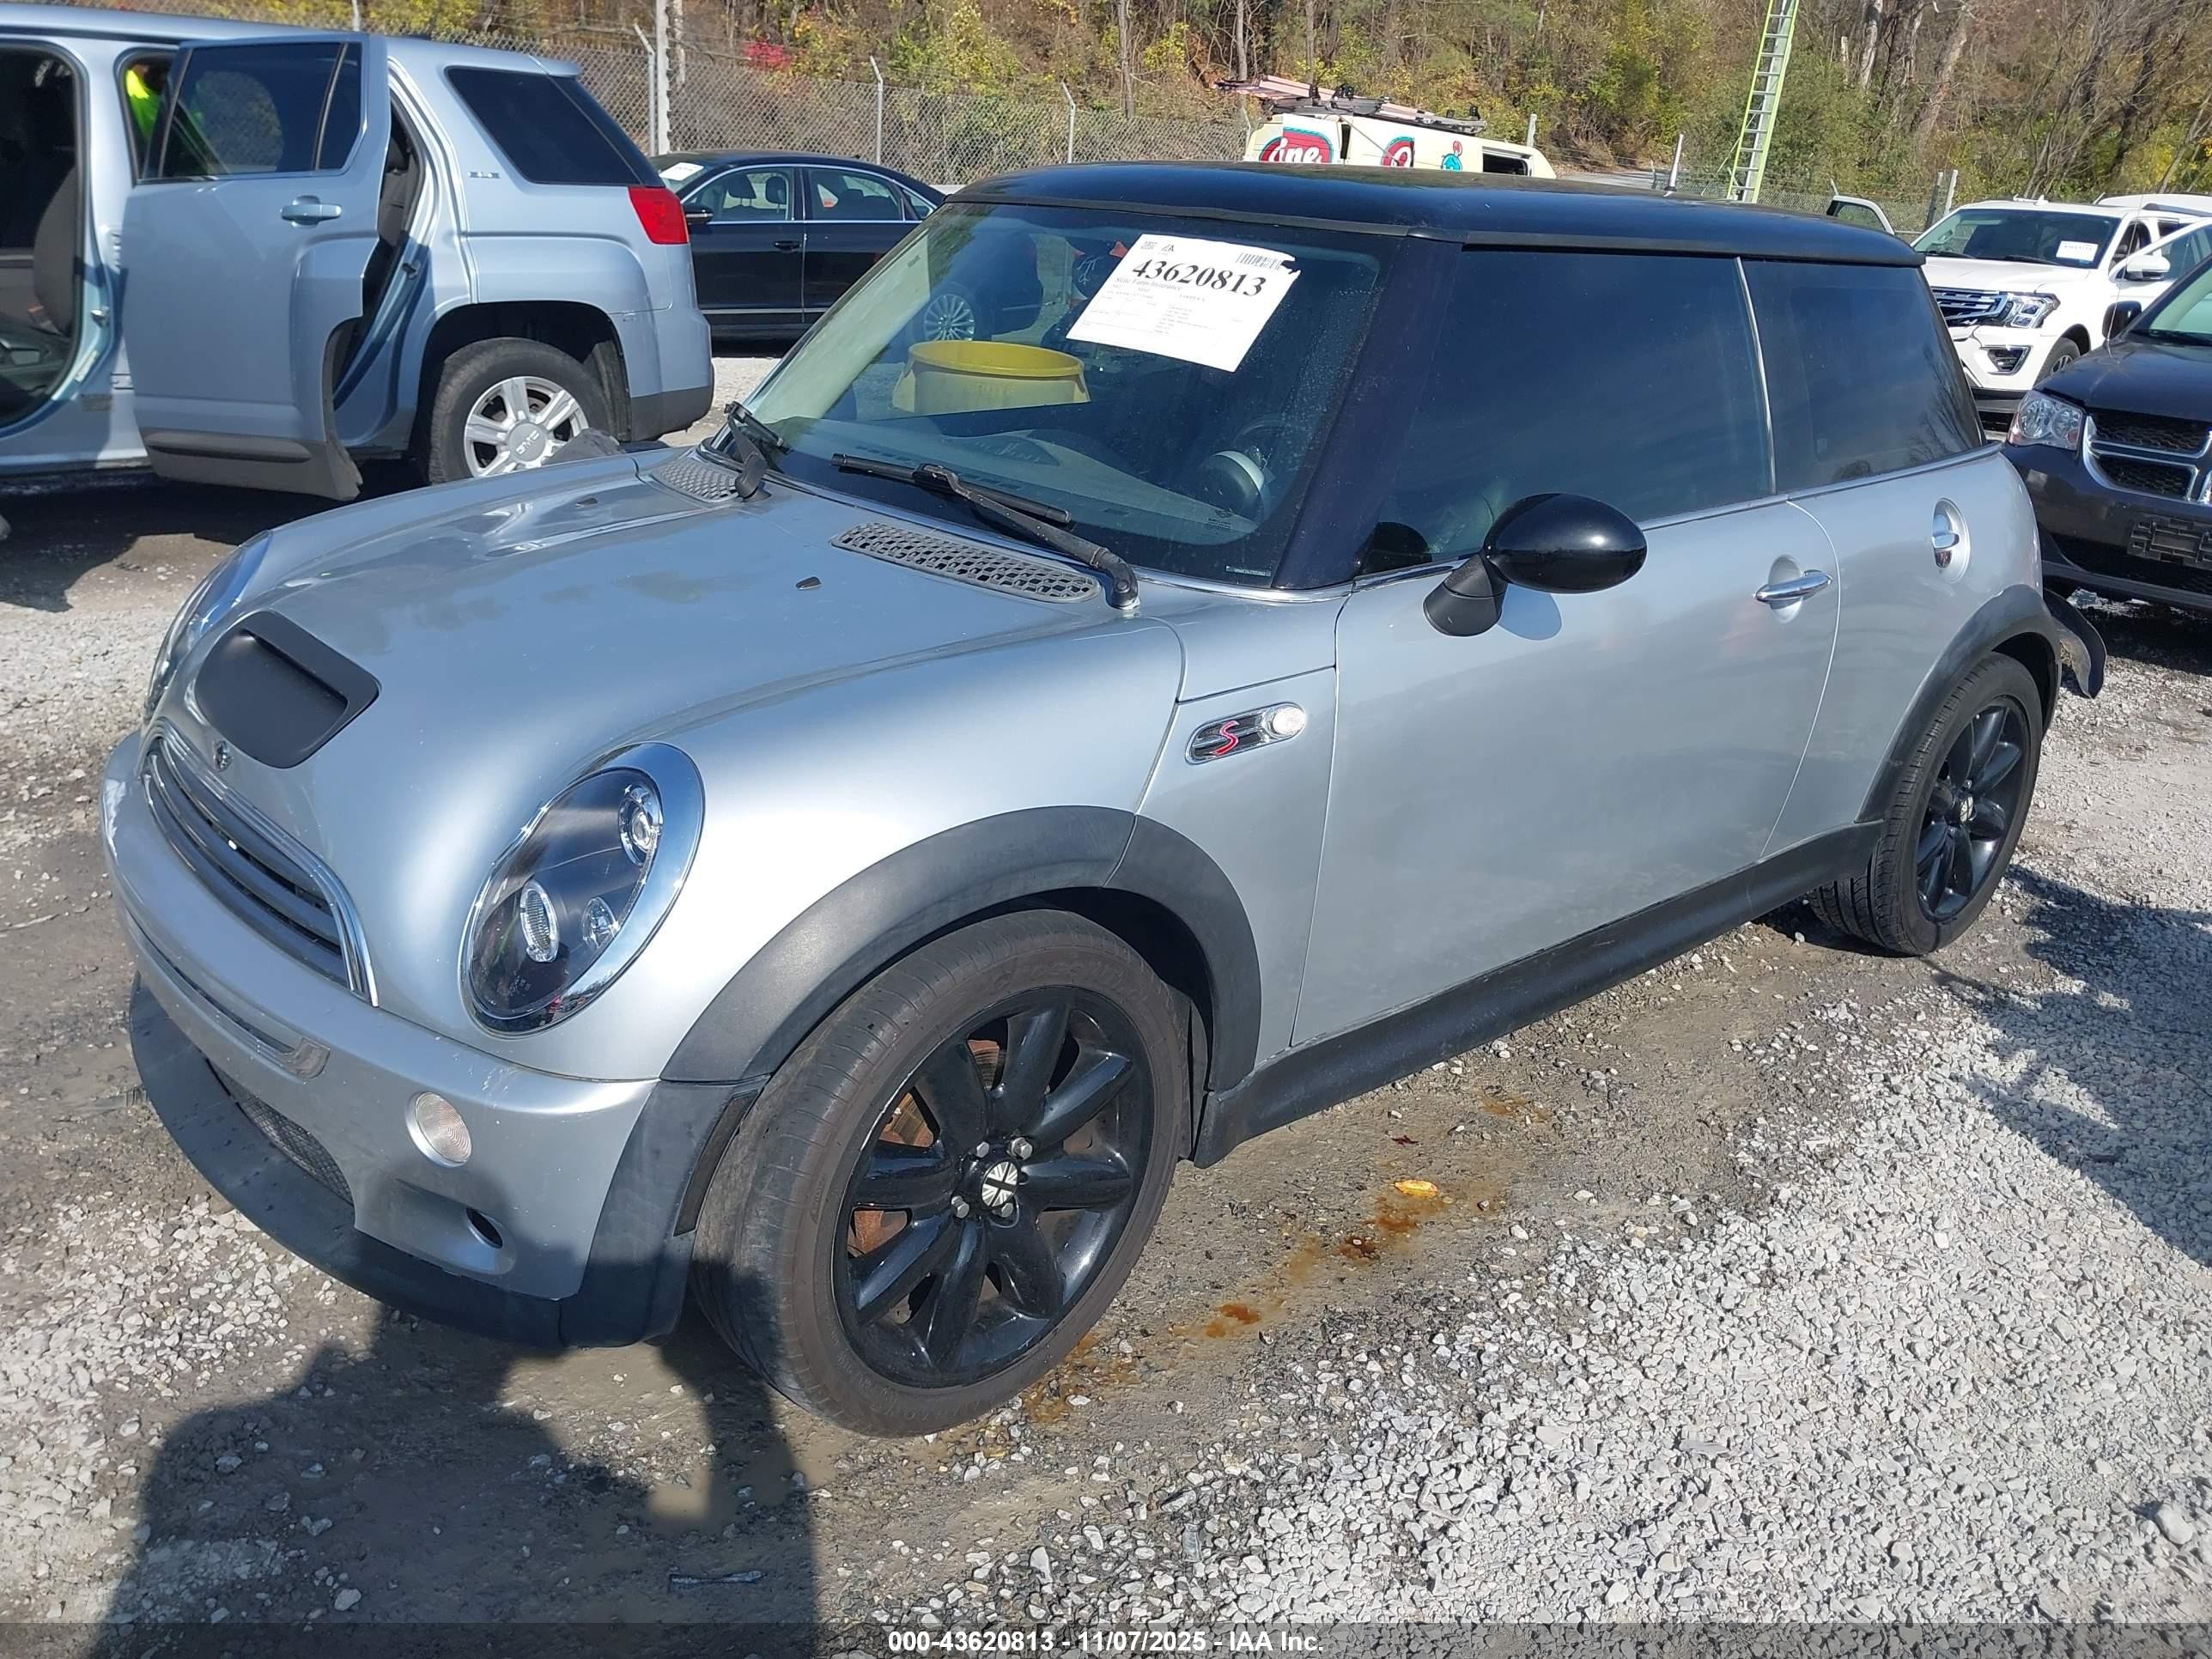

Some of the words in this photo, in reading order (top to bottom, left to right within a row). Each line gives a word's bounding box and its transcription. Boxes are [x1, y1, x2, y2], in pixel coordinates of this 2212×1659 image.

[1133, 258, 1267, 296] 43620813
[516, 430, 540, 455] GMC
[1212, 720, 1239, 756] S
